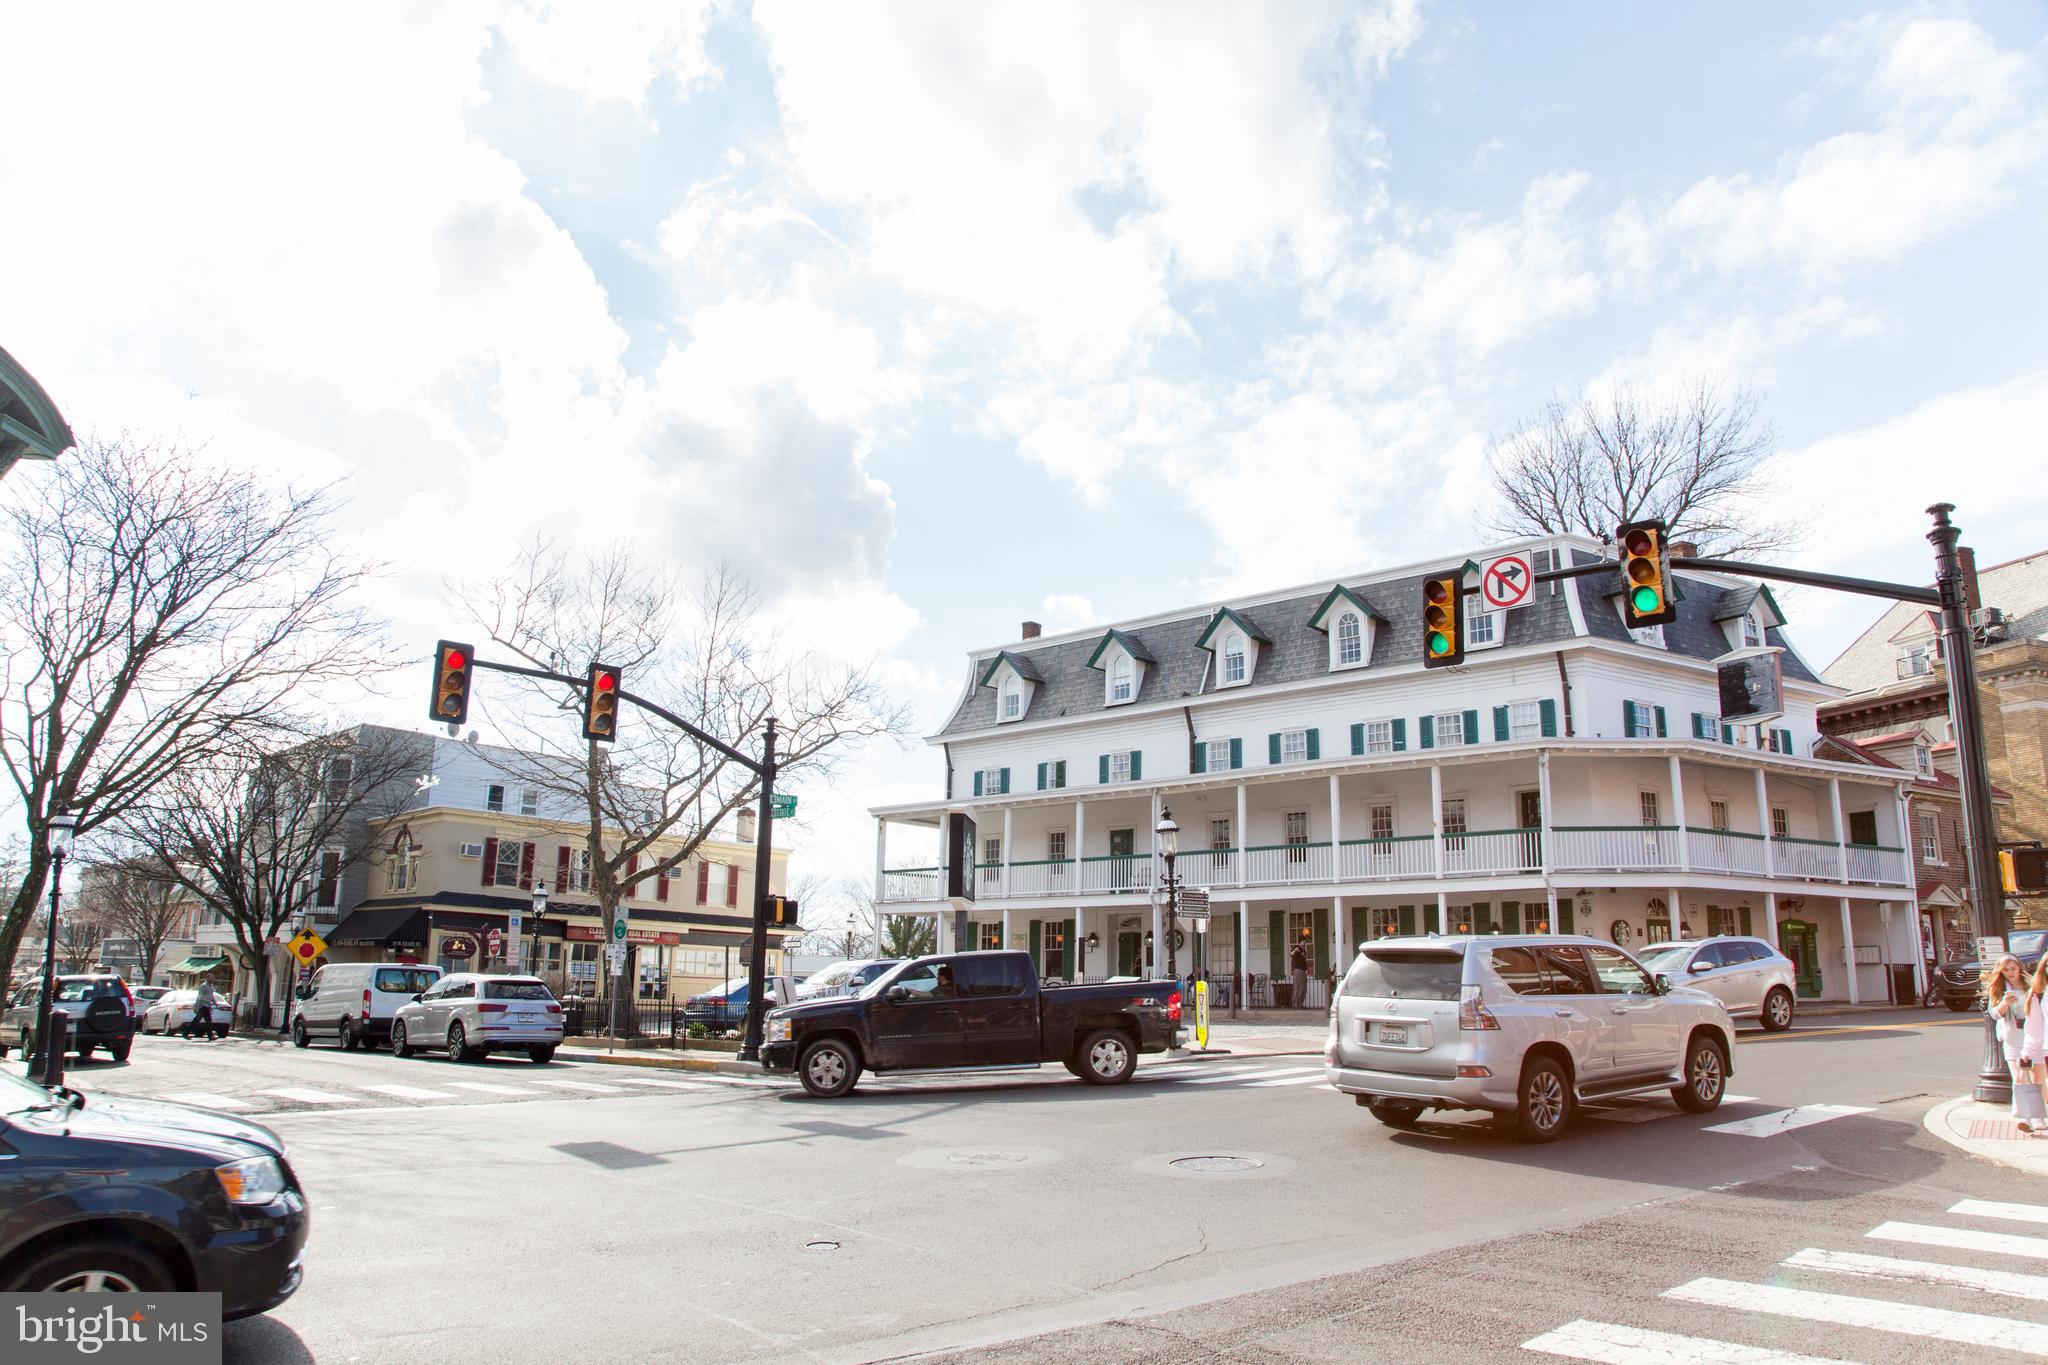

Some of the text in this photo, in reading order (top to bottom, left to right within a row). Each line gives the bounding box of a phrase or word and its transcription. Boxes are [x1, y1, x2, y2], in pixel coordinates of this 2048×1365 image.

[776, 795, 791, 805] MAIN
[628, 929, 641, 937] REAL
[642, 930, 660, 938] ESTATE
